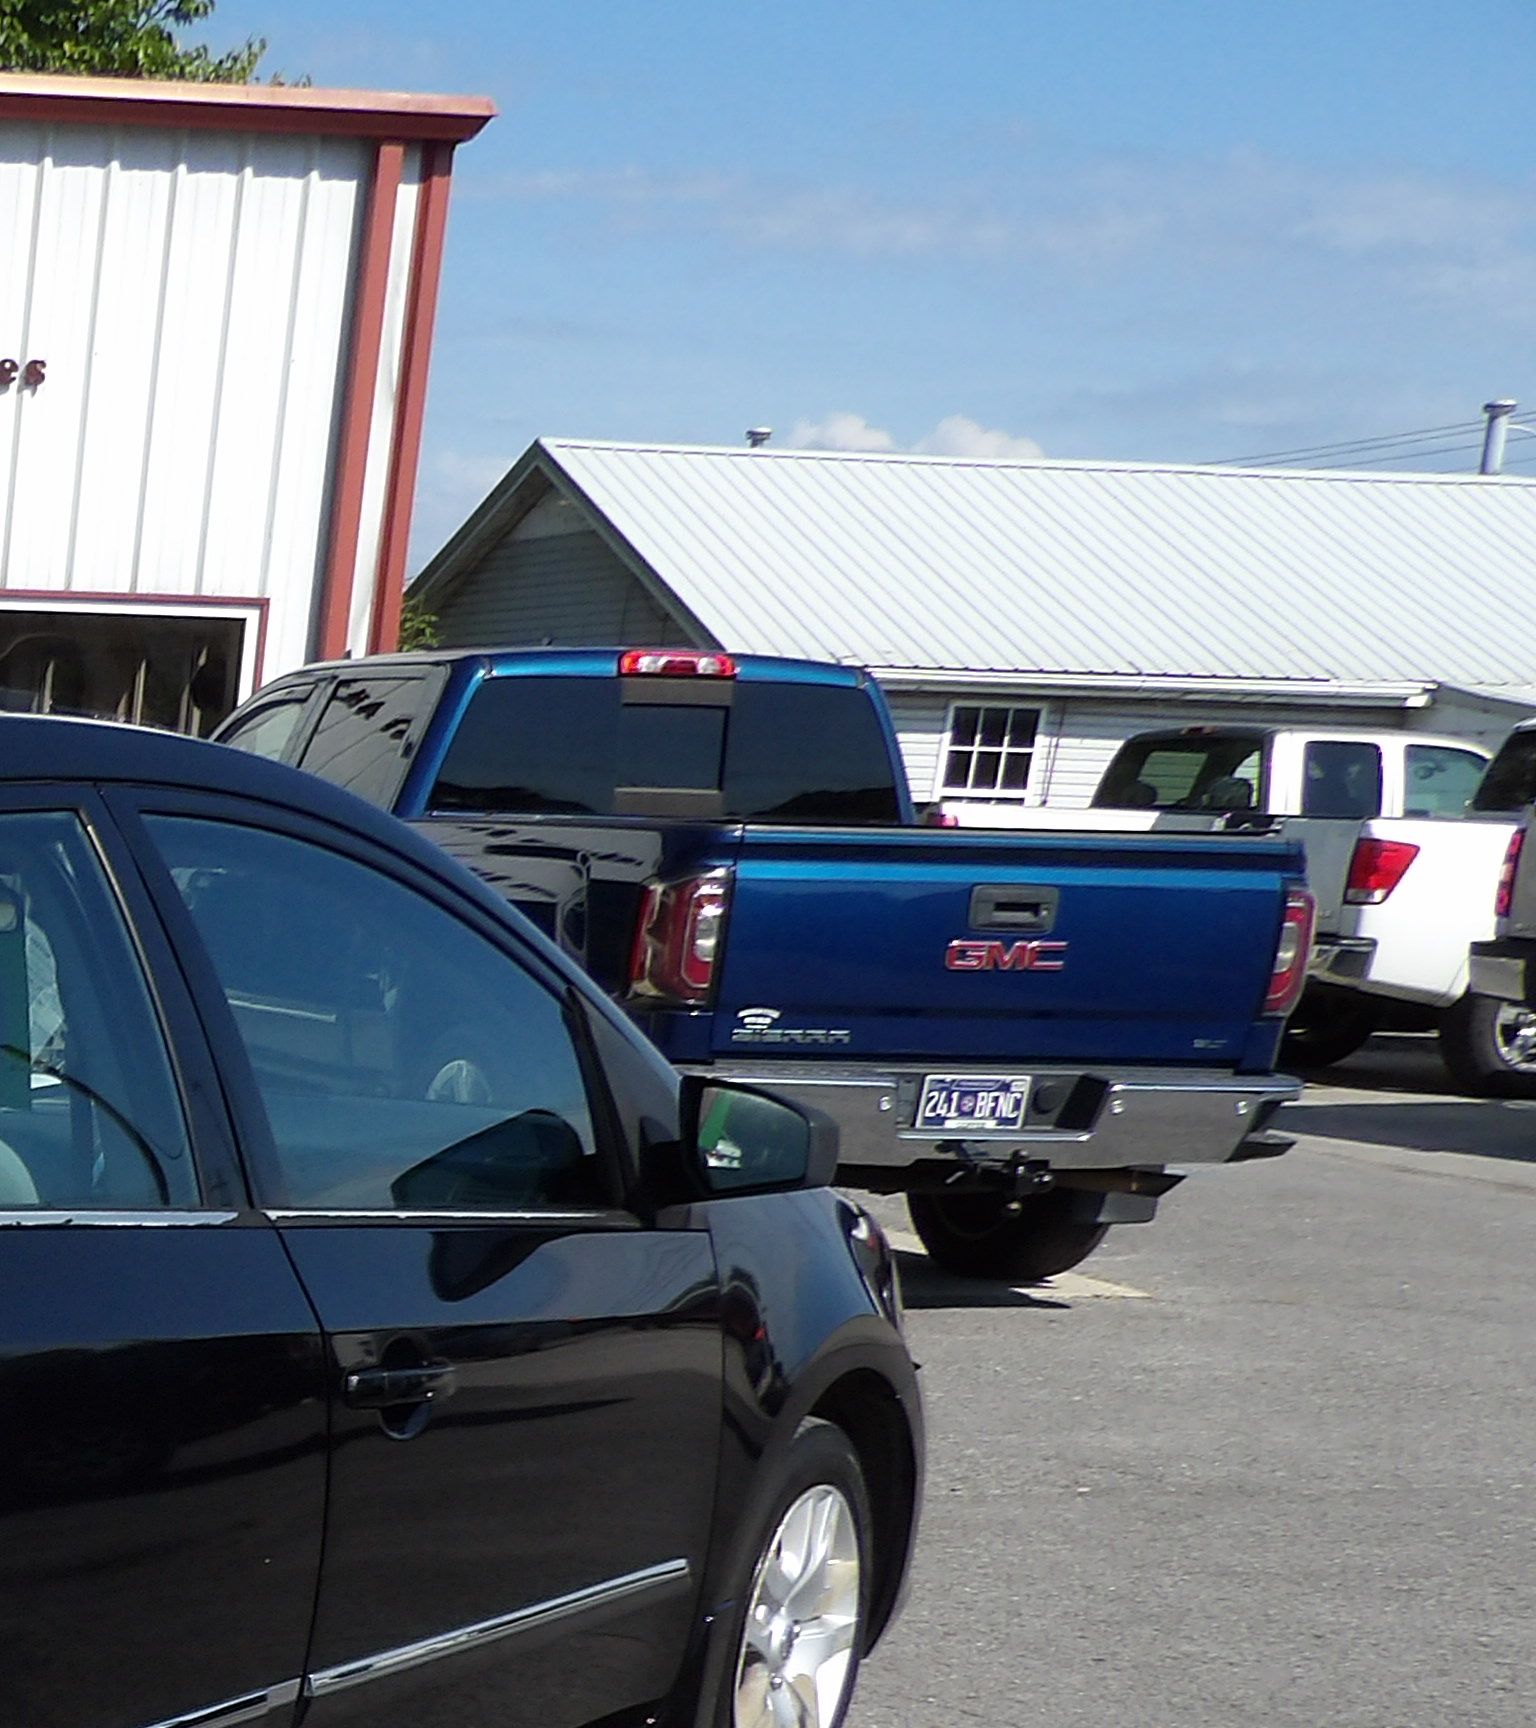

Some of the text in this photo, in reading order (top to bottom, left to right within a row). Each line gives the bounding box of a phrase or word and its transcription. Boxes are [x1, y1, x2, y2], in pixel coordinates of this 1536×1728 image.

[945, 939, 1068, 970] GMC
[924, 1091, 1023, 1118] 241 BFNC
